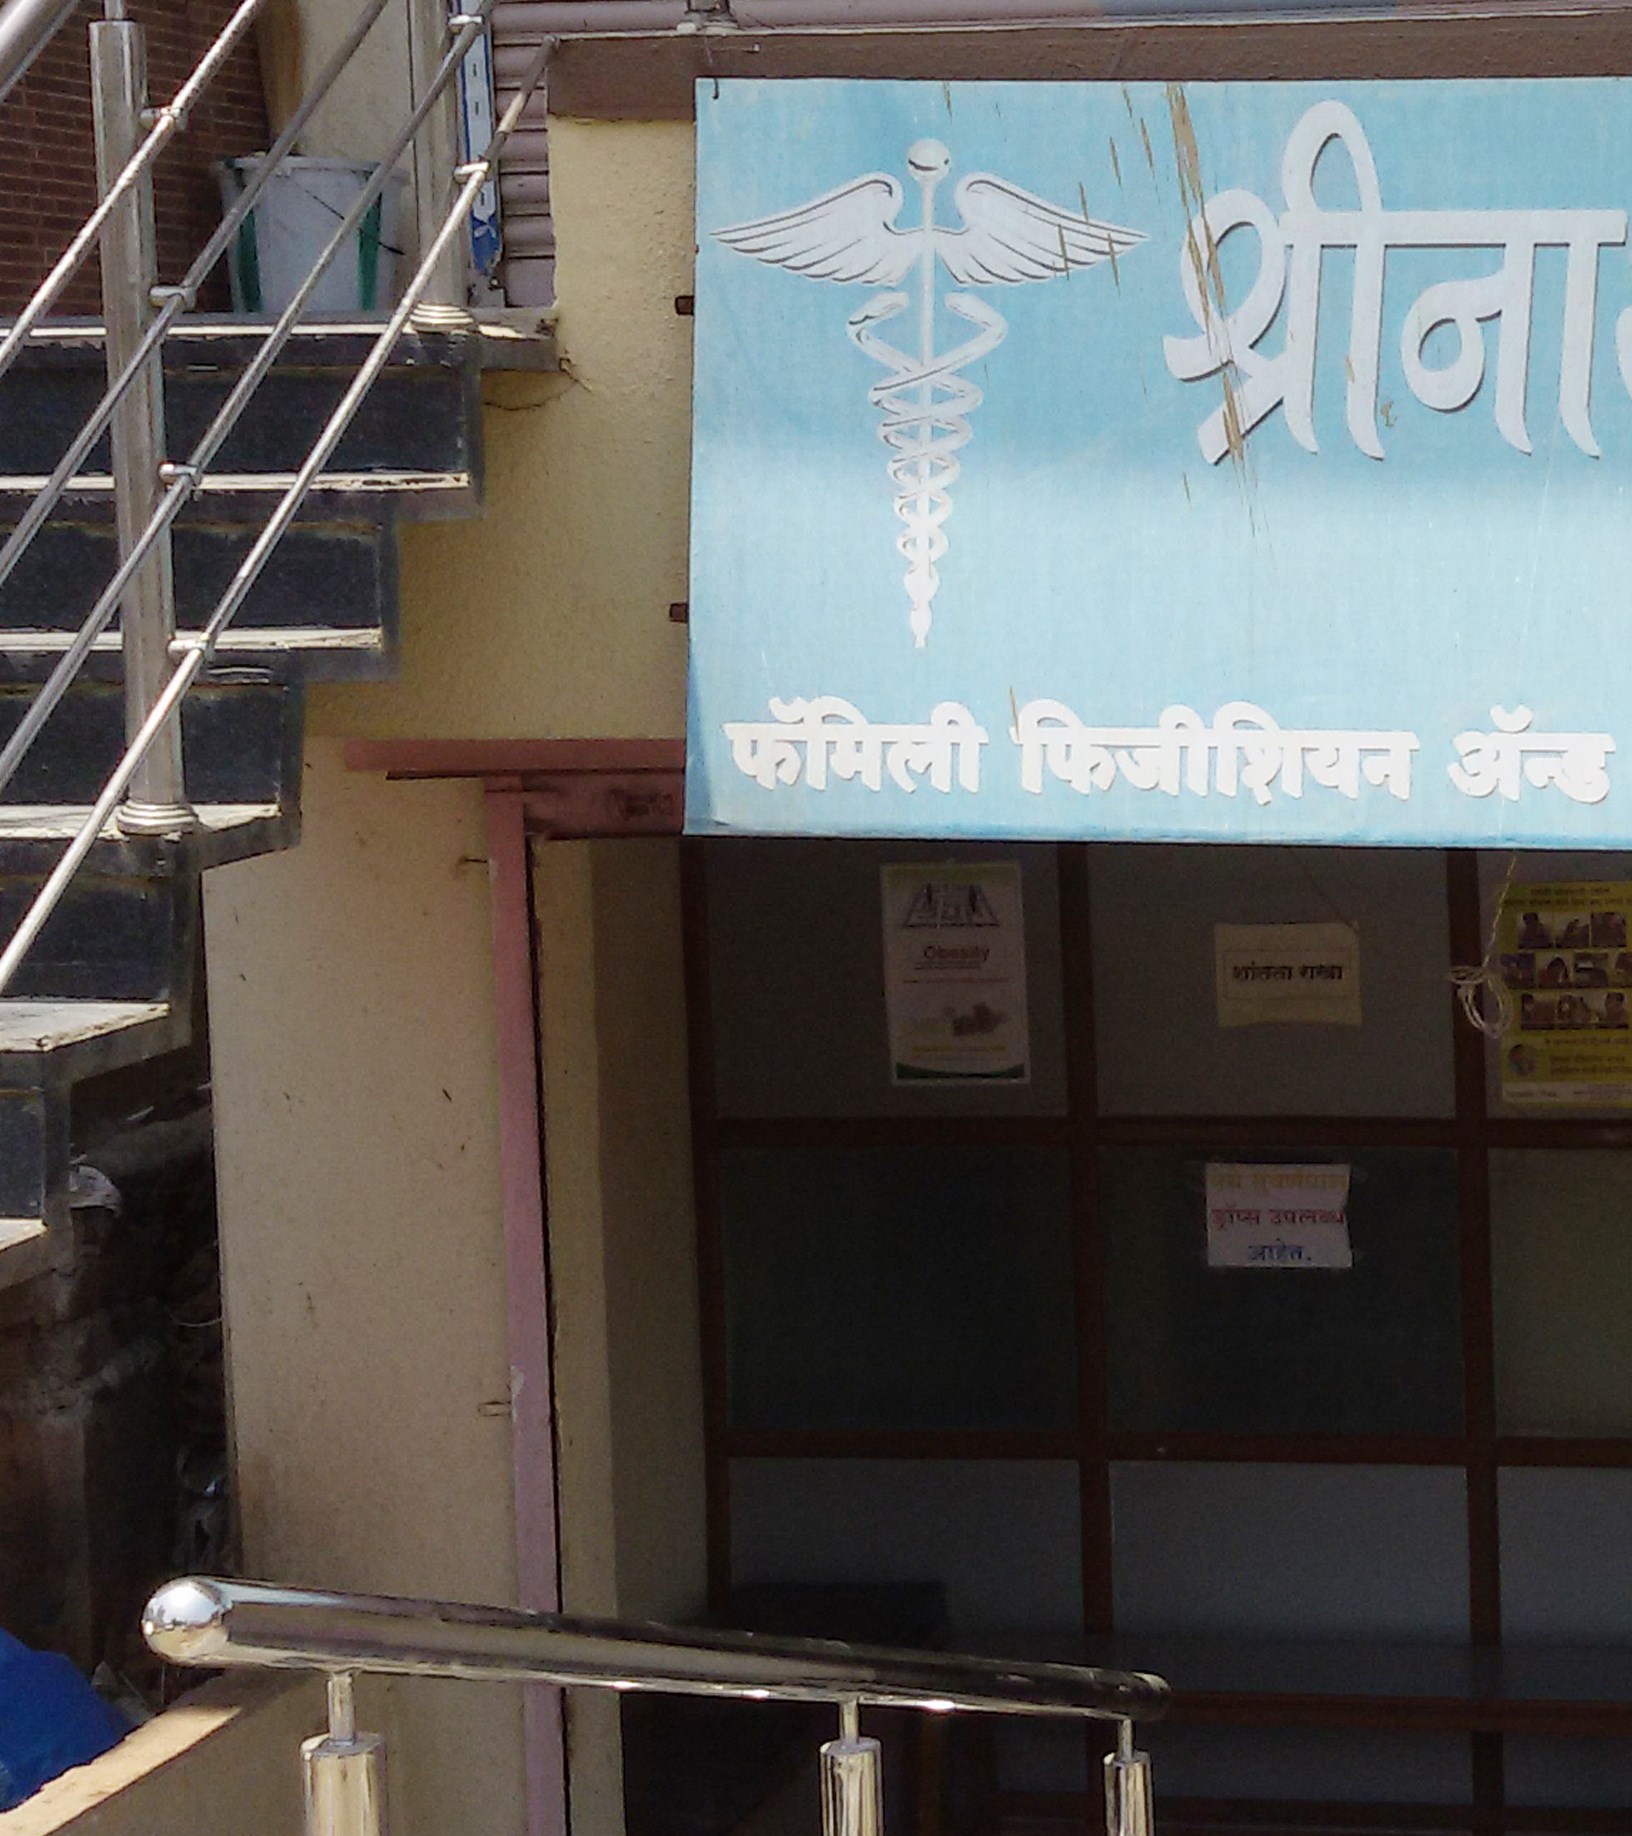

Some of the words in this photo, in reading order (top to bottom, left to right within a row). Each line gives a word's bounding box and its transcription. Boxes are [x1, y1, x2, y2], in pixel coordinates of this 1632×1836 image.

[720, 695, 989, 795] फॅमिली
[1009, 698, 1421, 806] फिजीशियन
[923, 945, 990, 962] Obesity
